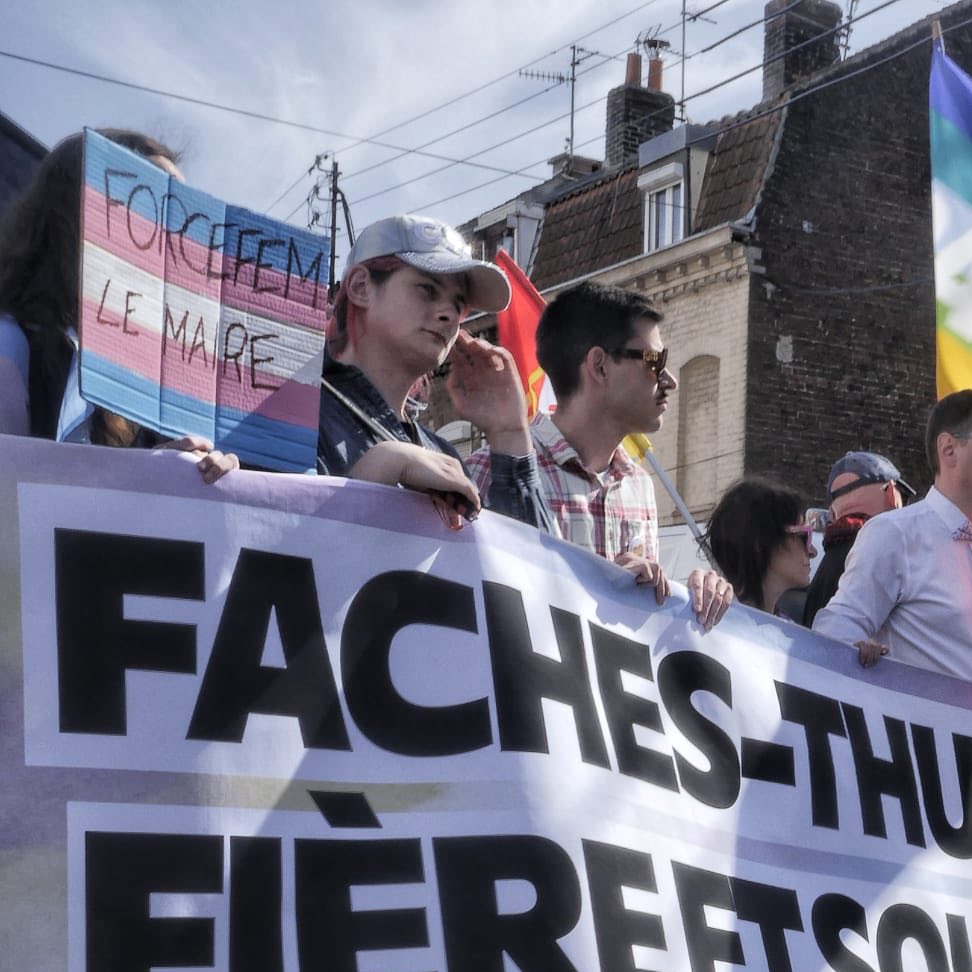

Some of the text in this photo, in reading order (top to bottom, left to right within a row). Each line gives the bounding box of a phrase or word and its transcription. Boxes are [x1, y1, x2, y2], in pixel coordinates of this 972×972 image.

[104, 167, 325, 311] FORCEFEM
[96, 279, 281, 391] LE MAIRE
